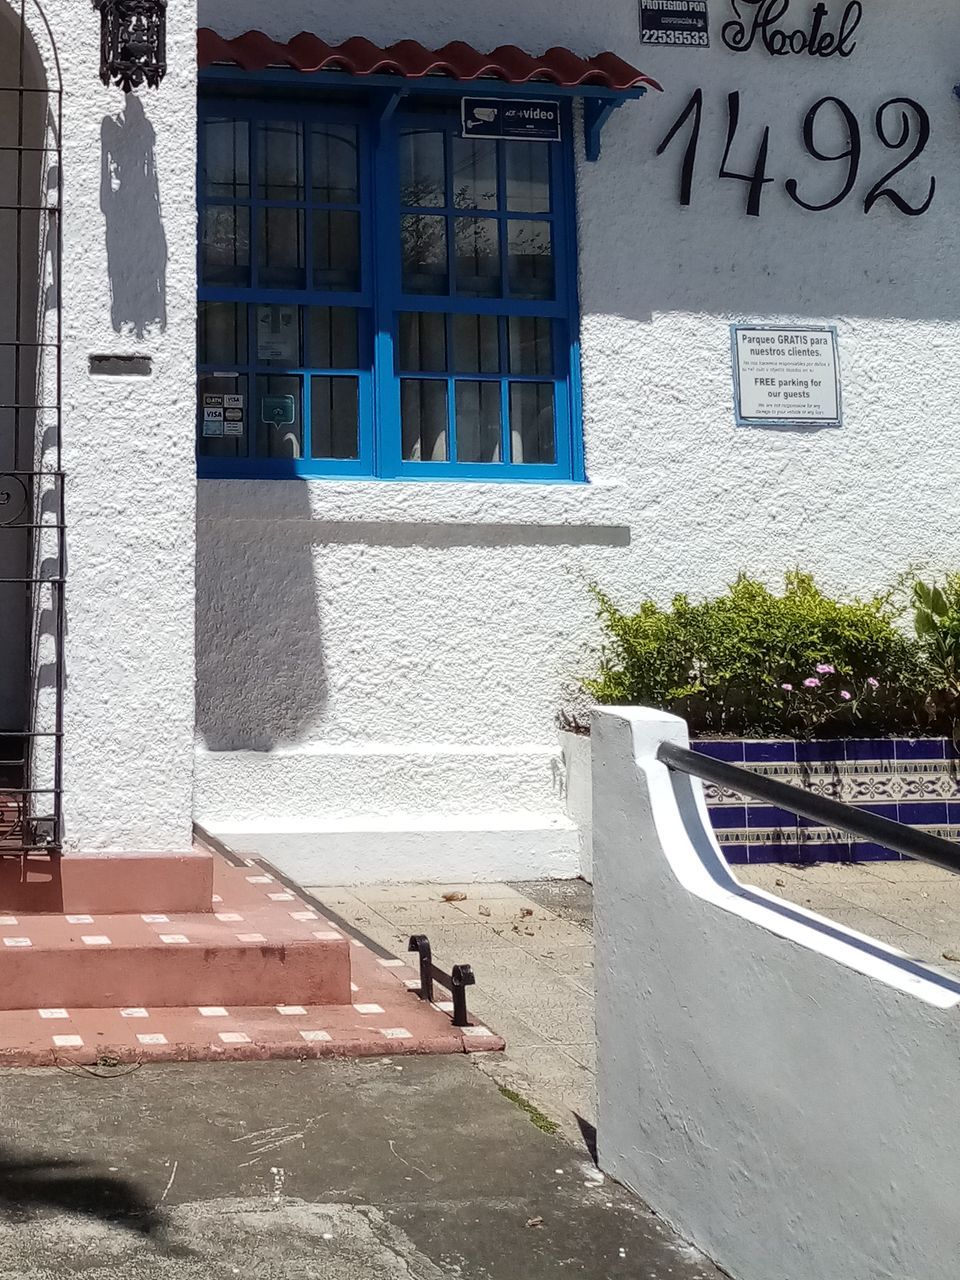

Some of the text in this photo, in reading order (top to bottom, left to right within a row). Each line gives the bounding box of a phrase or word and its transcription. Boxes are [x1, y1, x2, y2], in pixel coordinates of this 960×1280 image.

[641, 0, 706, 12] PROTEGIDO POR
[642, 29, 708, 45] 22535533
[656, 88, 936, 217] 1492
[742, 334, 828, 346] Parqueo GRATIS para
[750, 346, 822, 357] nuestros clientes.
[754, 377, 822, 388] FREE parking for
[783, 391, 810, 400] guests
